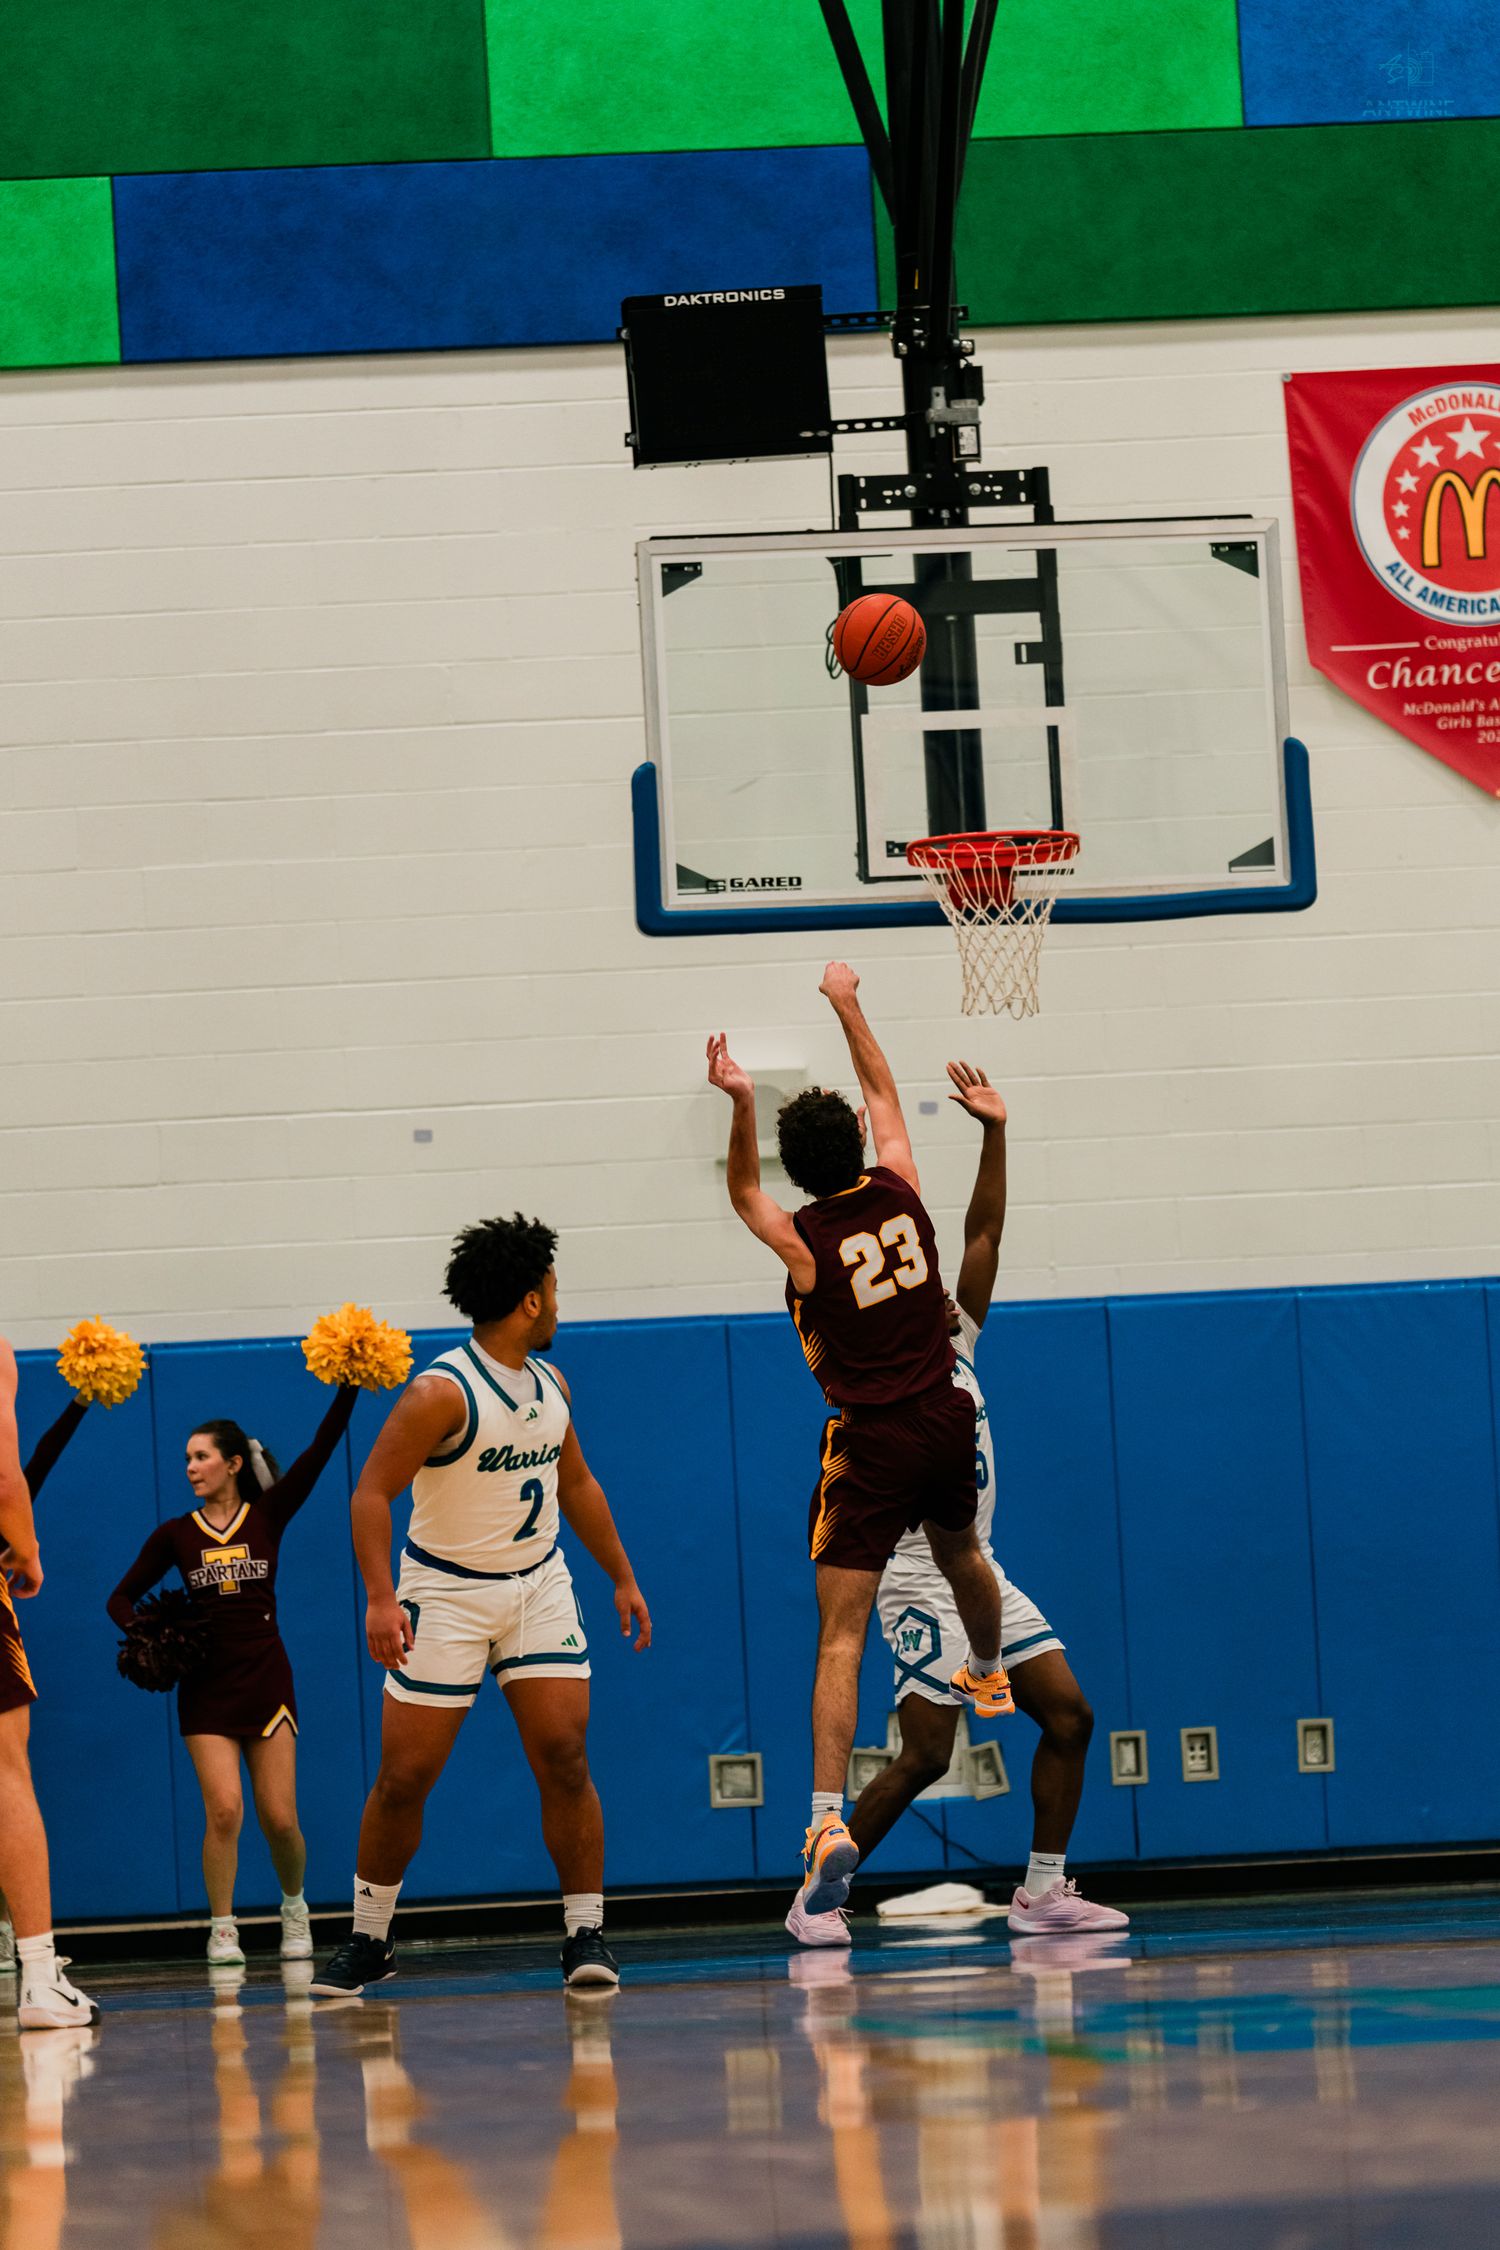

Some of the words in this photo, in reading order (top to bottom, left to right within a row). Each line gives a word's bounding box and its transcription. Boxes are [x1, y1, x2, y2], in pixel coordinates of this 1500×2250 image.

[663, 289, 786, 307] DAKTRONICS
[1407, 392, 1500, 427] McDONAL
[1385, 561, 1414, 592] ALL
[1367, 656, 1500, 690] Chance
[1403, 698, 1485, 716] McDonald's
[1436, 714, 1472, 730] Girls
[730, 876, 802, 888] GARED
[838, 1213, 928, 1310] 23
[512, 1477, 544, 1542] 2
[188, 1560, 268, 1589] SPARTANS
[201, 1544, 251, 1595] T
[901, 1629, 923, 1651] W
